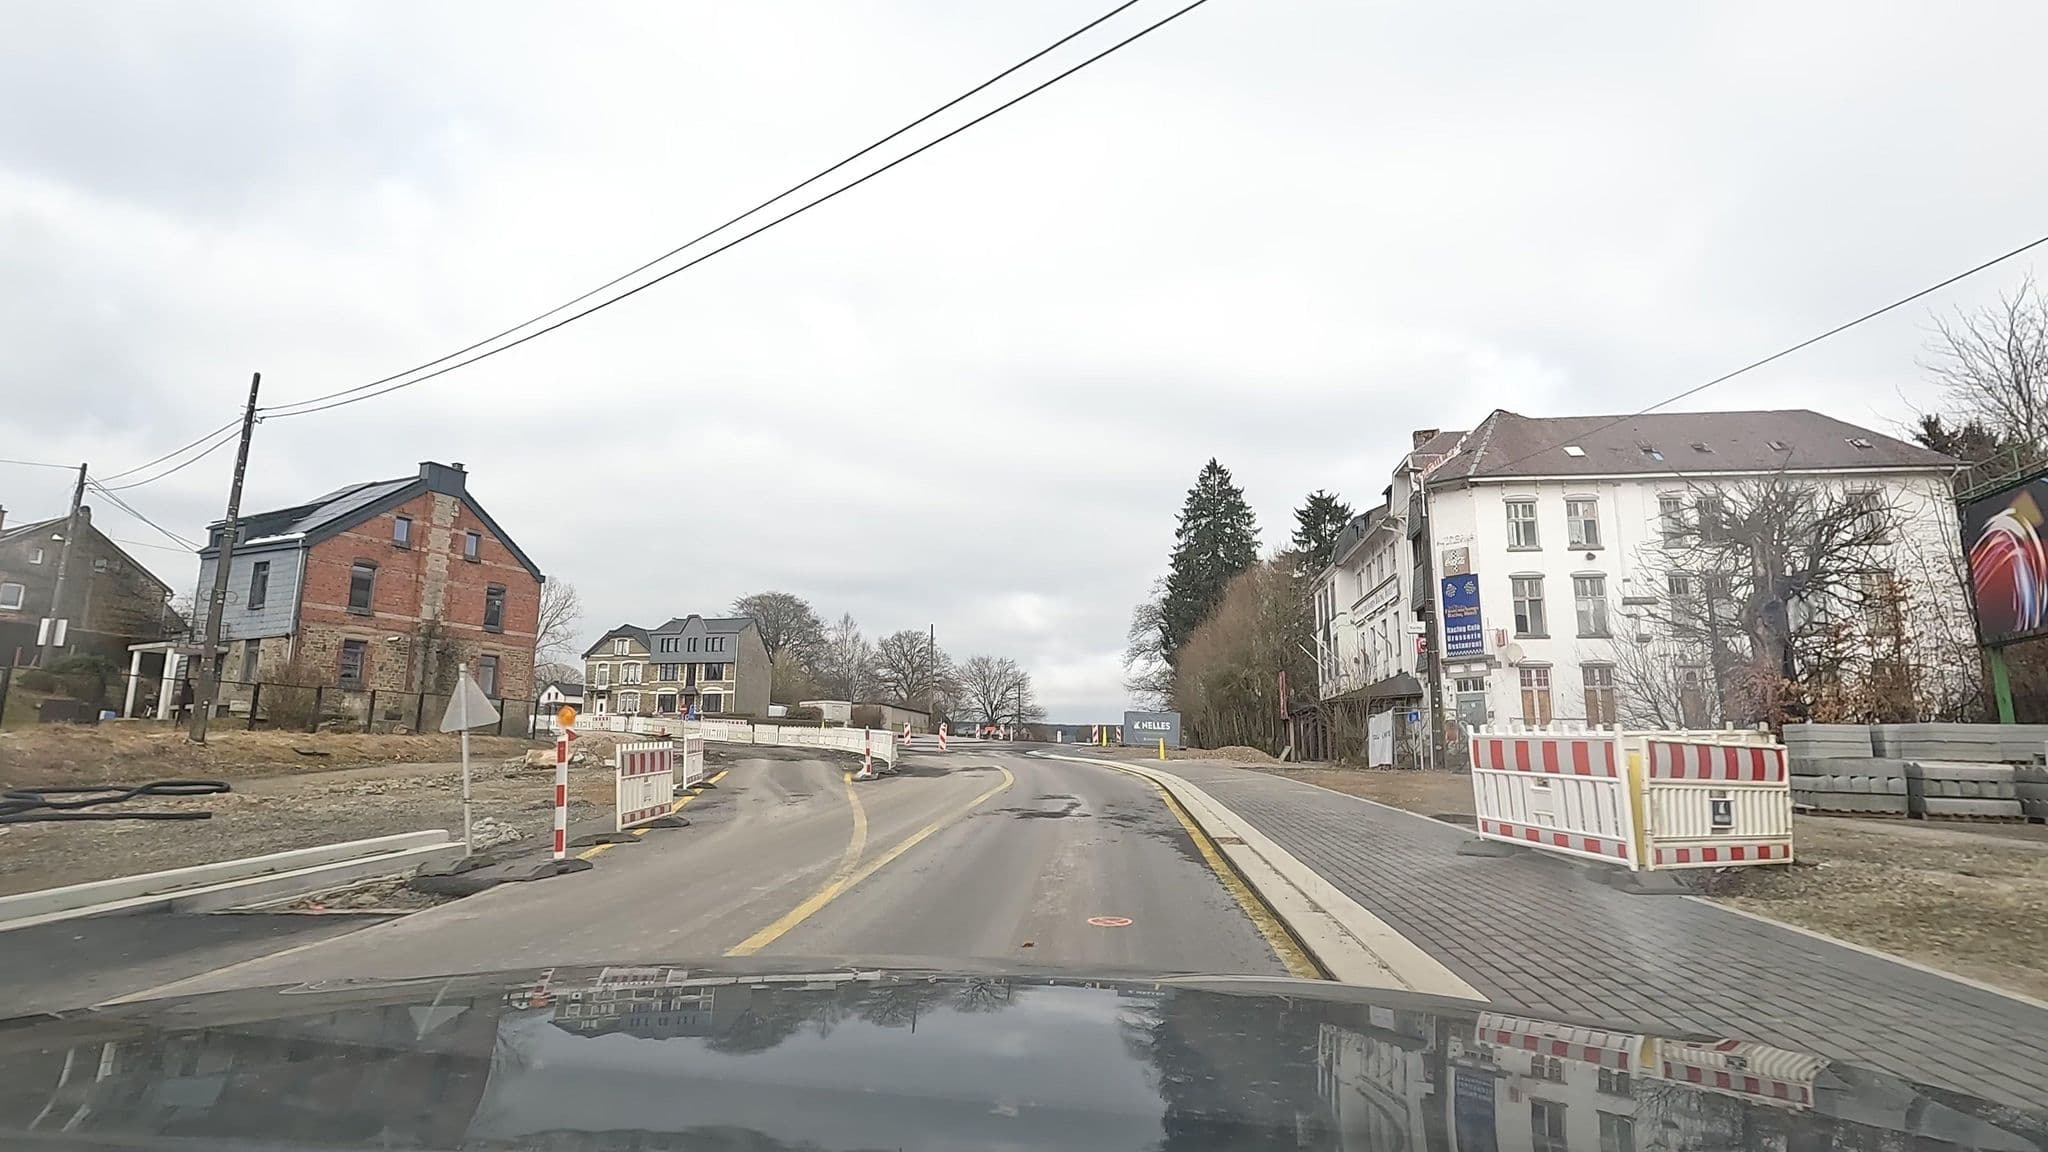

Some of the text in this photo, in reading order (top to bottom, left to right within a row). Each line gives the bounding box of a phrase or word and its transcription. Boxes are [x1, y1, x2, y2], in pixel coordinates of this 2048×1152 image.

[1447, 632, 1481, 642] Brasserie
[1447, 640, 1482, 650] Restaurant
[1142, 721, 1171, 730] NELLES
